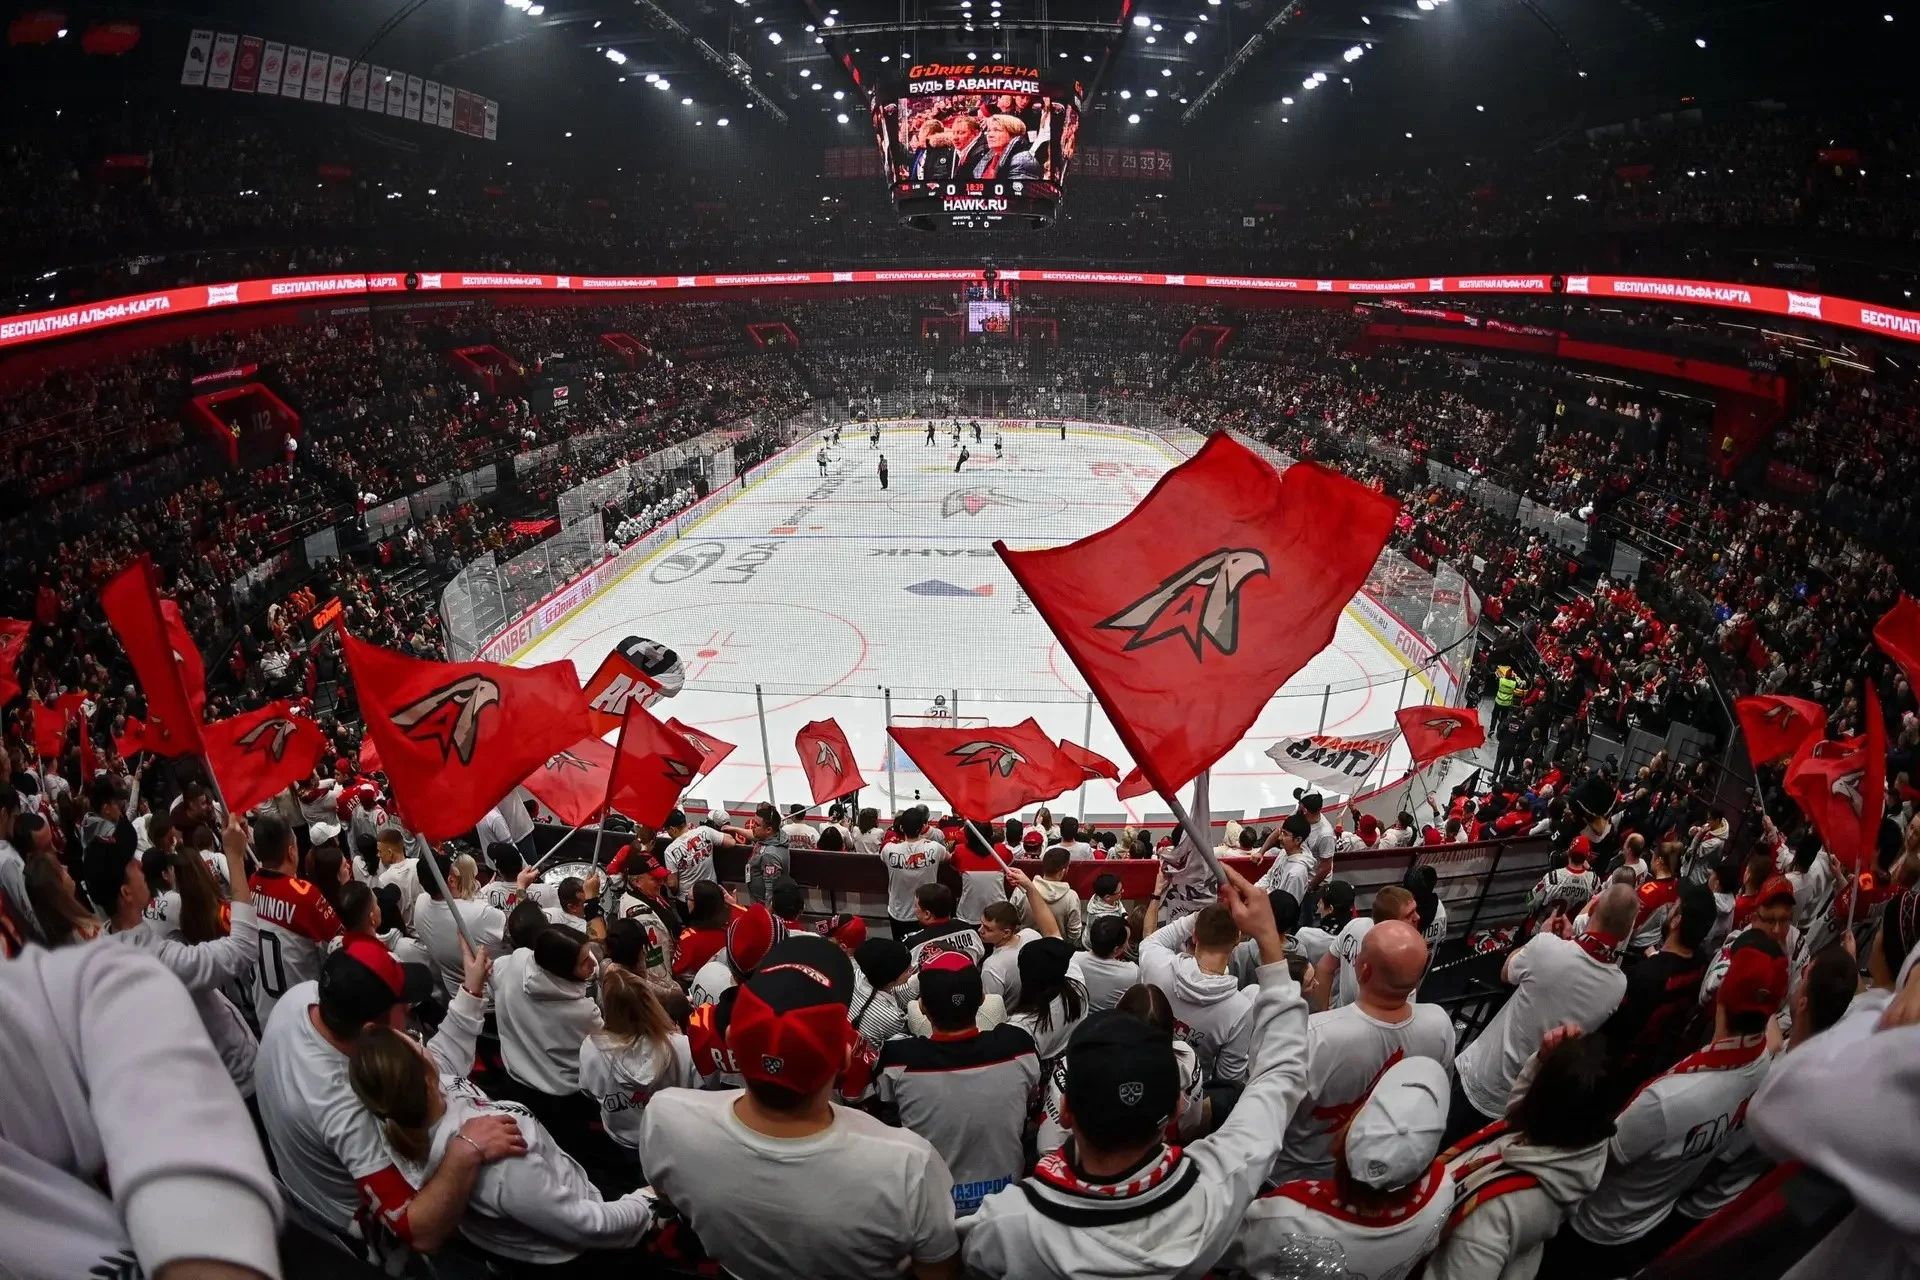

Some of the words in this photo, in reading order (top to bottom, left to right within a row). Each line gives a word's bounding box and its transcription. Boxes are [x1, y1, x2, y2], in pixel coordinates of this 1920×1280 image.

[979, 65, 1039, 77] АРЕНА
[909, 80, 943, 94] БУДЬ
[946, 80, 954, 91] В
[958, 79, 1040, 93] АВАНГАРДЕ
[1140, 158, 1155, 170] 33
[1158, 158, 1172, 171] 24
[947, 184, 956, 195] 0
[966, 183, 984, 191] 18:39
[995, 184, 1003, 195] 0
[944, 199, 1008, 211] HAWK.RU
[272, 278, 336, 295] БЕСПЛАТНАЯ
[337, 277, 397, 290] АЛЬФА-КАРТА
[1614, 281, 1675, 296] БЕСПЛАТНАЯ
[1676, 284, 1751, 304] АЛЬФА-КАРТА
[1, 312, 78, 339] БЕСПЛАТНАЯ
[79, 297, 170, 325] АЛЬФА-КАРТА
